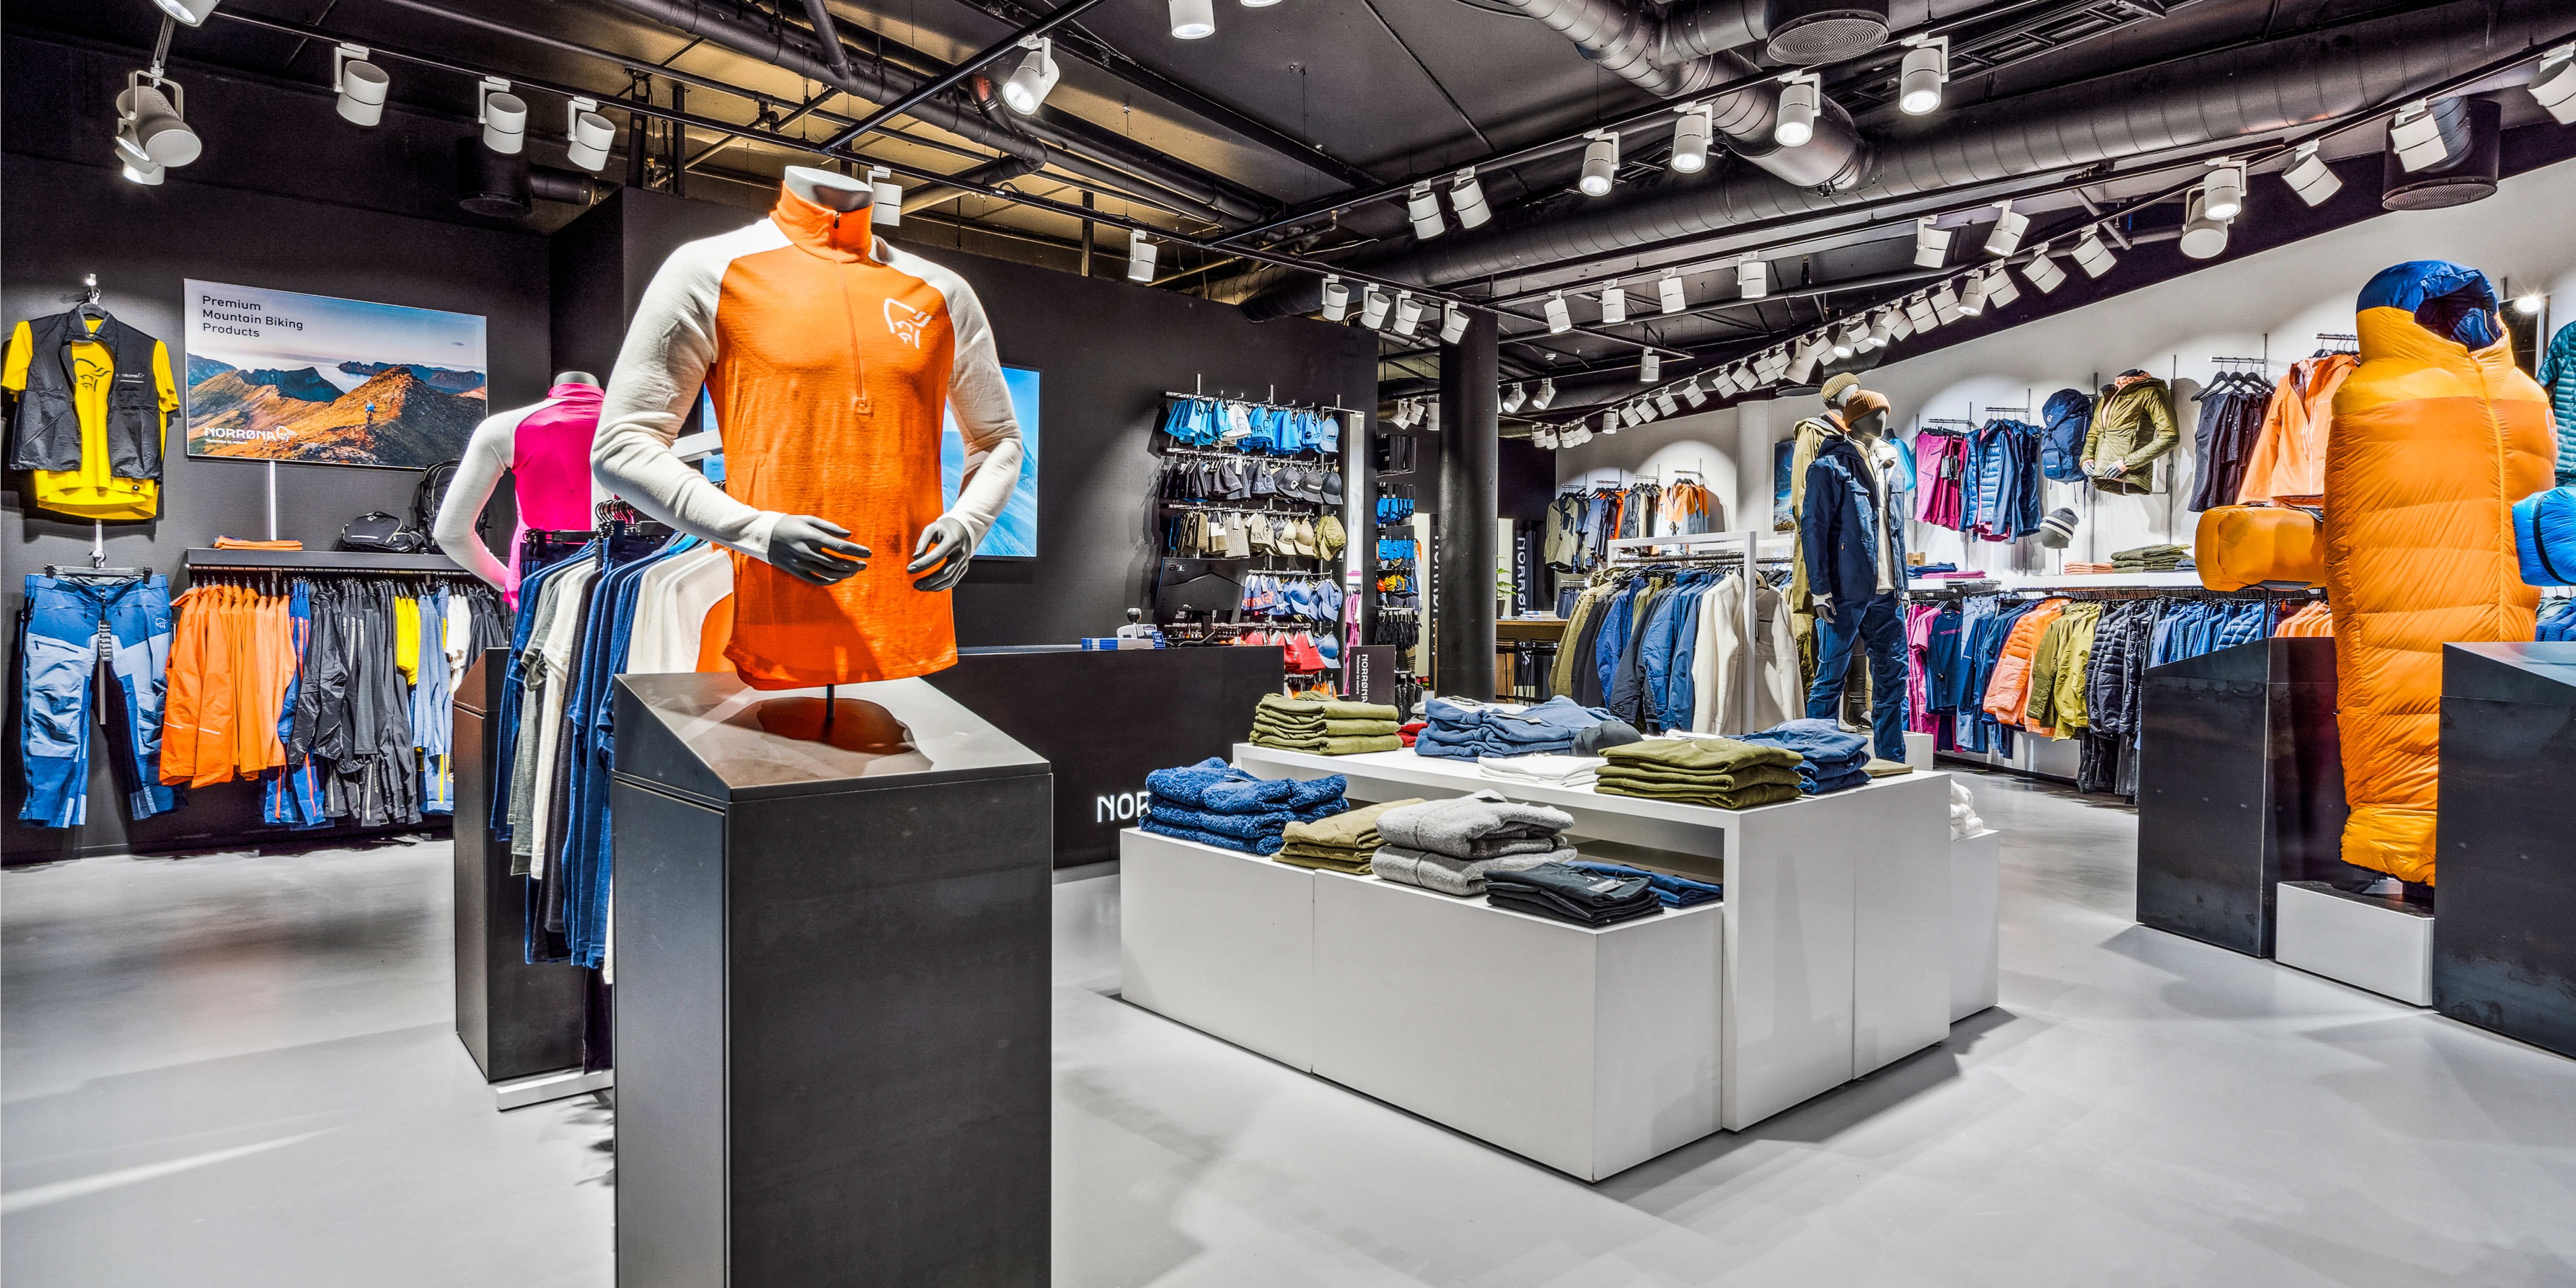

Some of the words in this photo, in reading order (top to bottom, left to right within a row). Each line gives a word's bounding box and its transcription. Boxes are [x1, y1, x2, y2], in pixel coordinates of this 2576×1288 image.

[202, 295, 261, 311] Premium
[203, 309, 261, 324] Mountain
[266, 316, 303, 331] Biking
[203, 323, 260, 337] Products
[204, 427, 277, 441] NORRØNA
